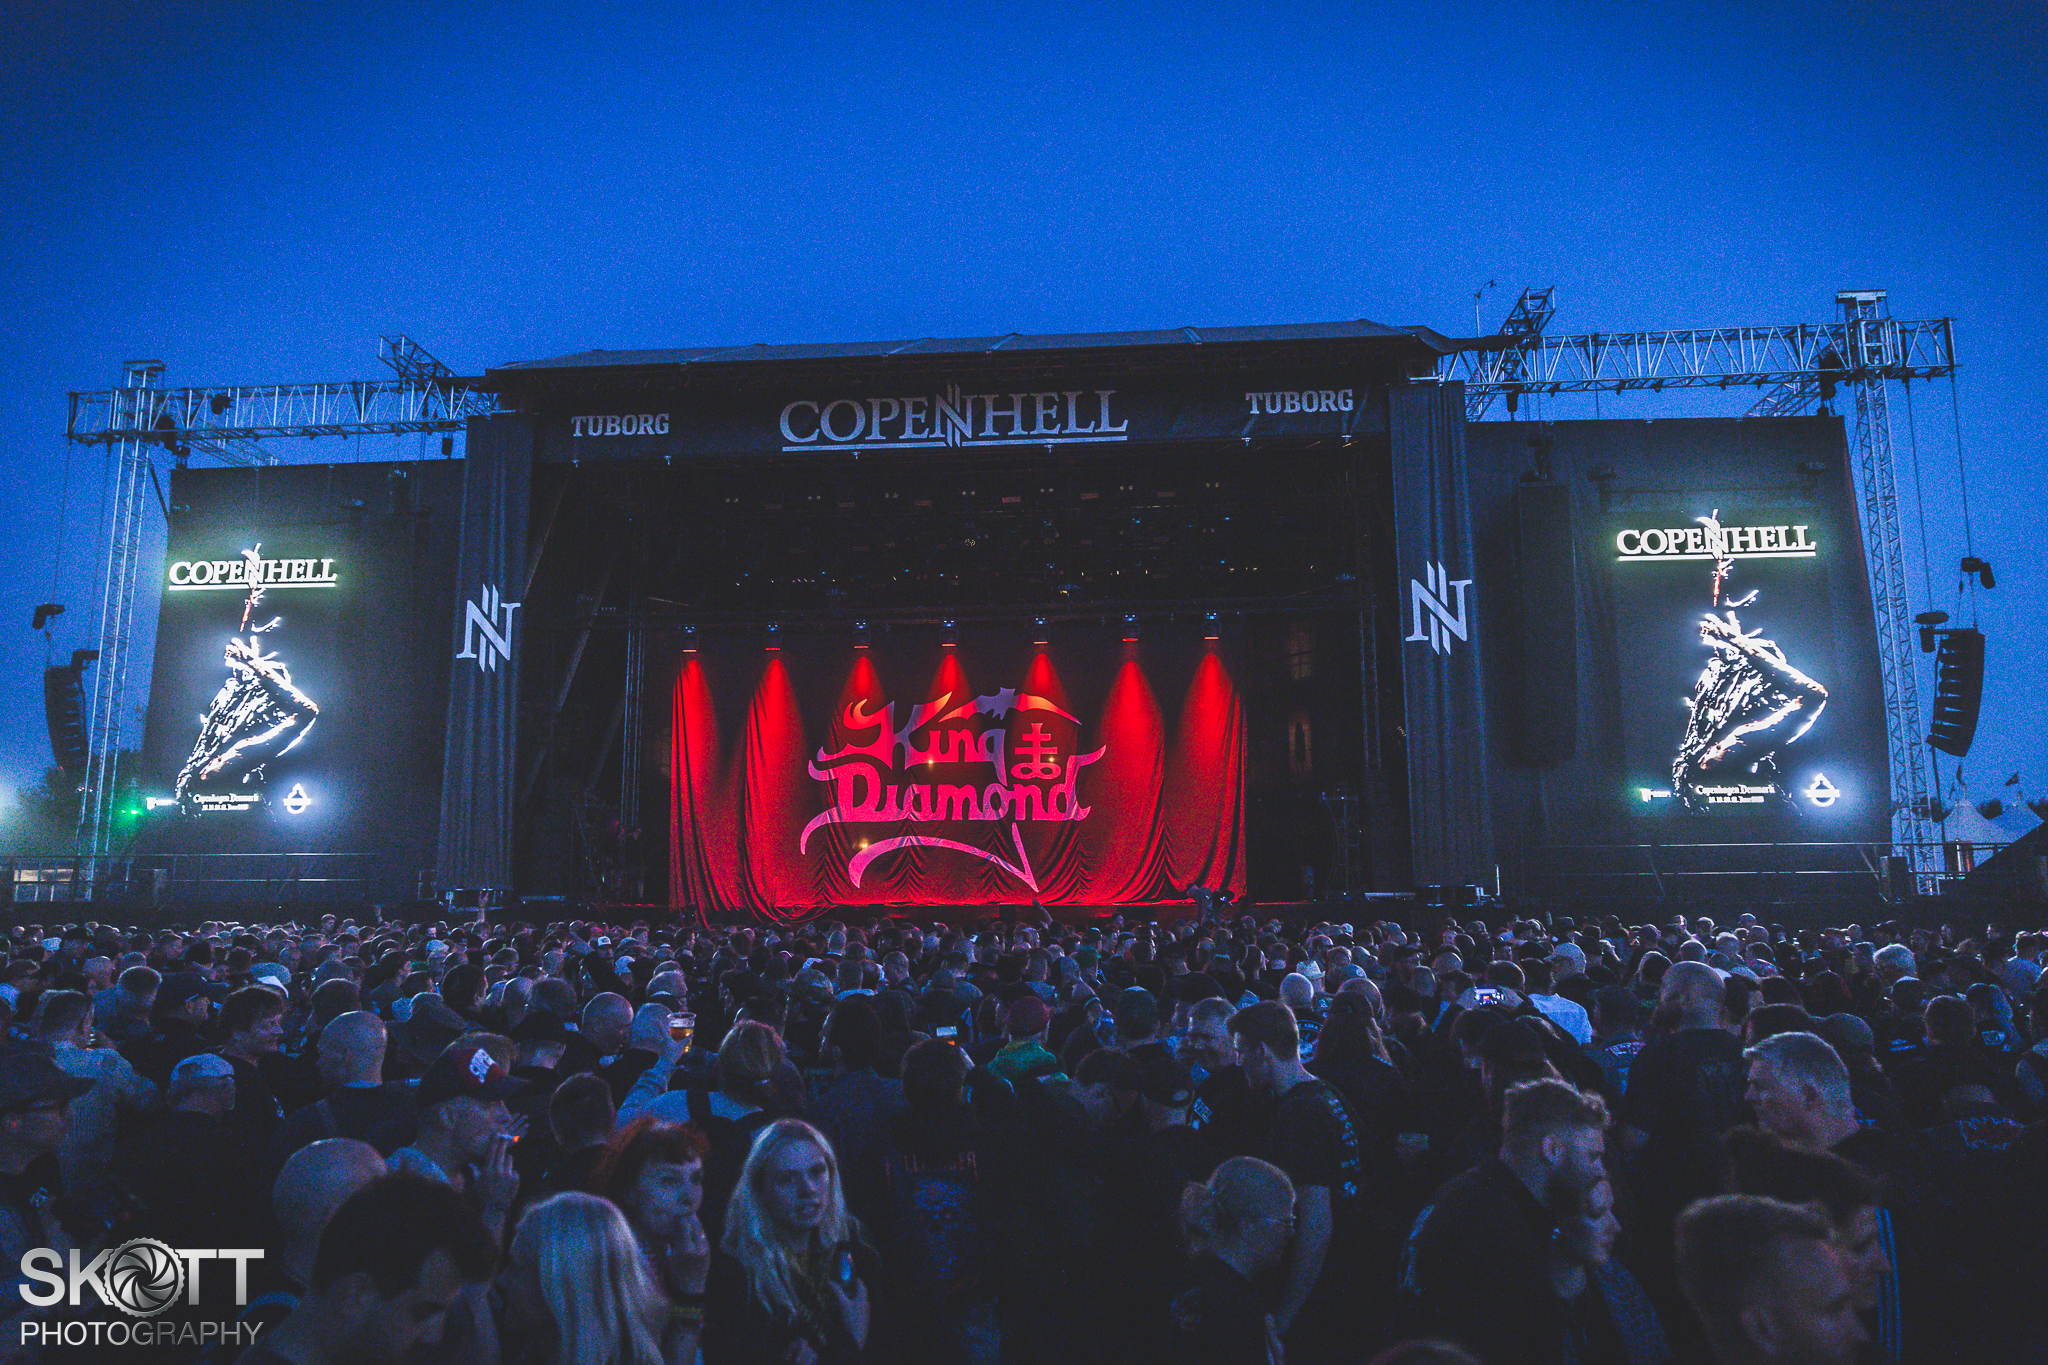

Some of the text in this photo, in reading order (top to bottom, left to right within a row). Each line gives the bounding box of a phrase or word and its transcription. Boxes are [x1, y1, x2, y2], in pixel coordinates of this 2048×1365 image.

[780, 383, 1128, 447] COPENHELL
[1246, 389, 1354, 415] TUBORG
[571, 413, 669, 437] TUBORG
[1617, 525, 1816, 559] COPENHELL
[169, 558, 337, 588] COPENHELL
